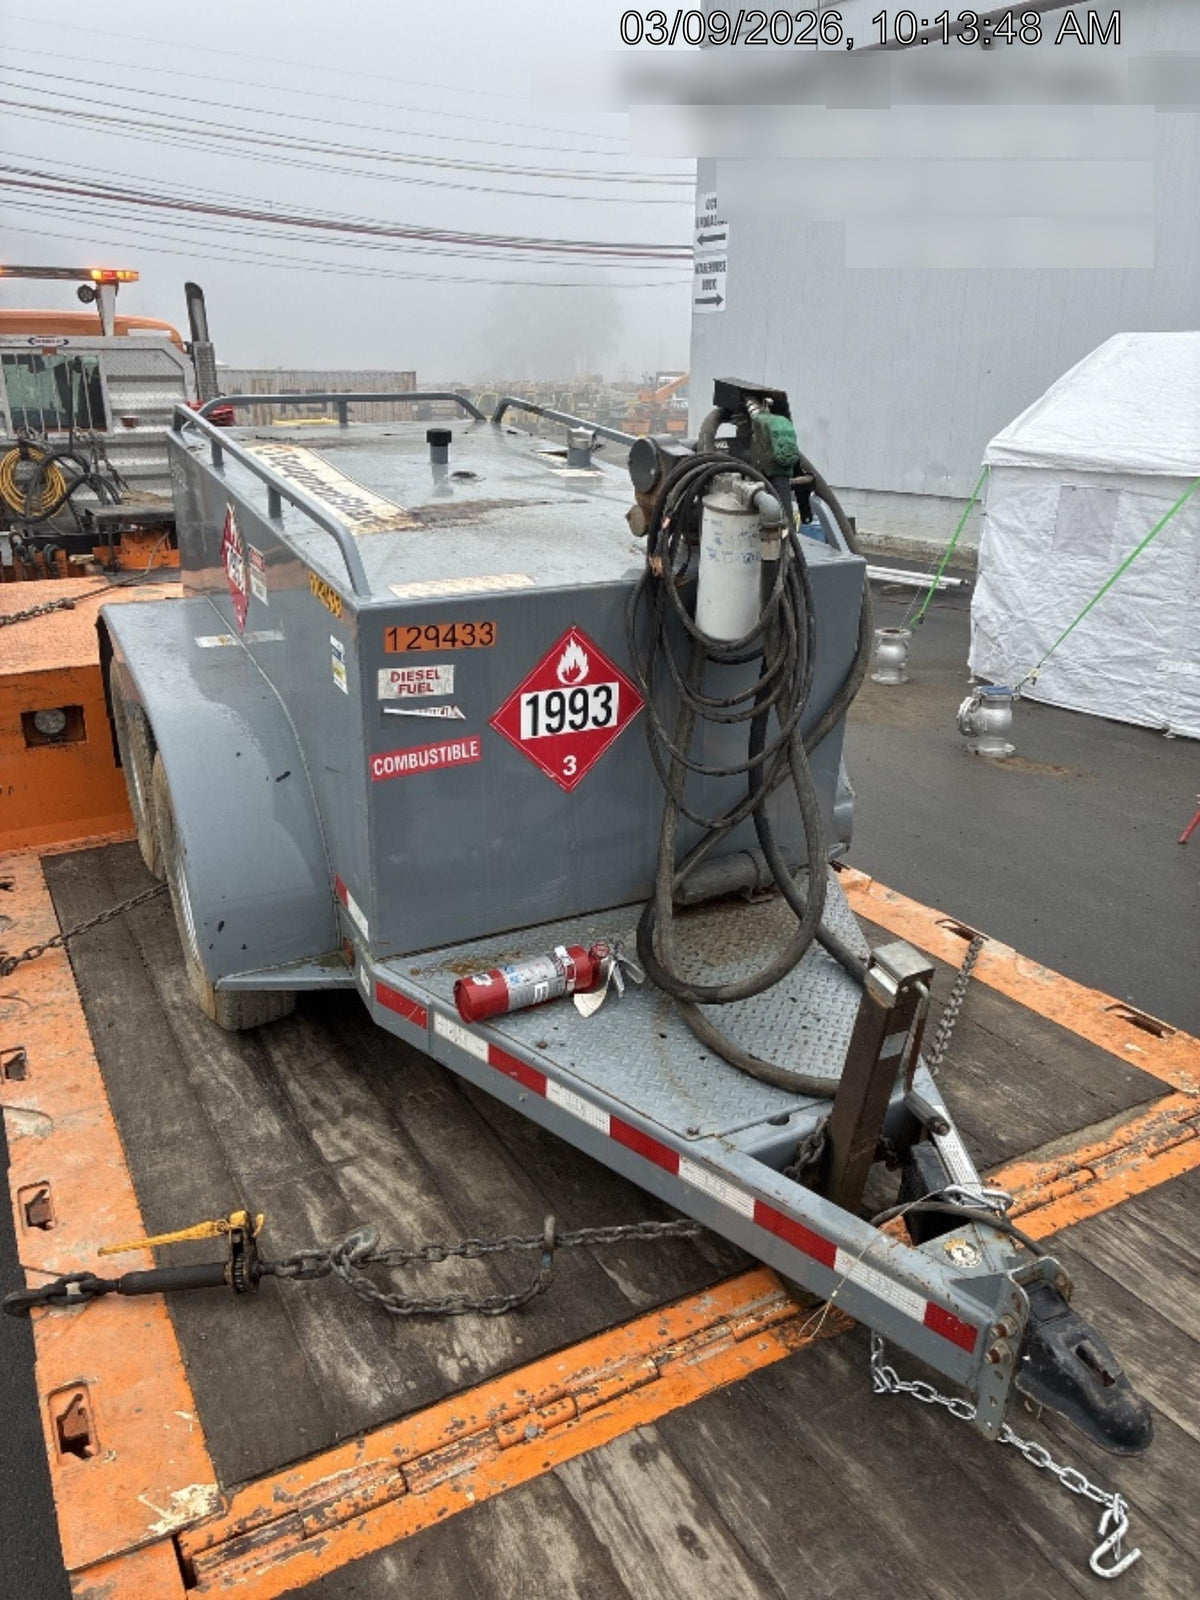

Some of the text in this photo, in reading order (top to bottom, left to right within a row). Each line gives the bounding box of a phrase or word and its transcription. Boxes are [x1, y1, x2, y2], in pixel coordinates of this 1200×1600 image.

[387, 621, 494, 652] 129433
[390, 668, 442, 683] DIESEL
[397, 681, 434, 696] FUEL
[525, 684, 613, 737] 1993
[373, 741, 479, 776] COMBUSTIBLE
[562, 755, 577, 776] 3
